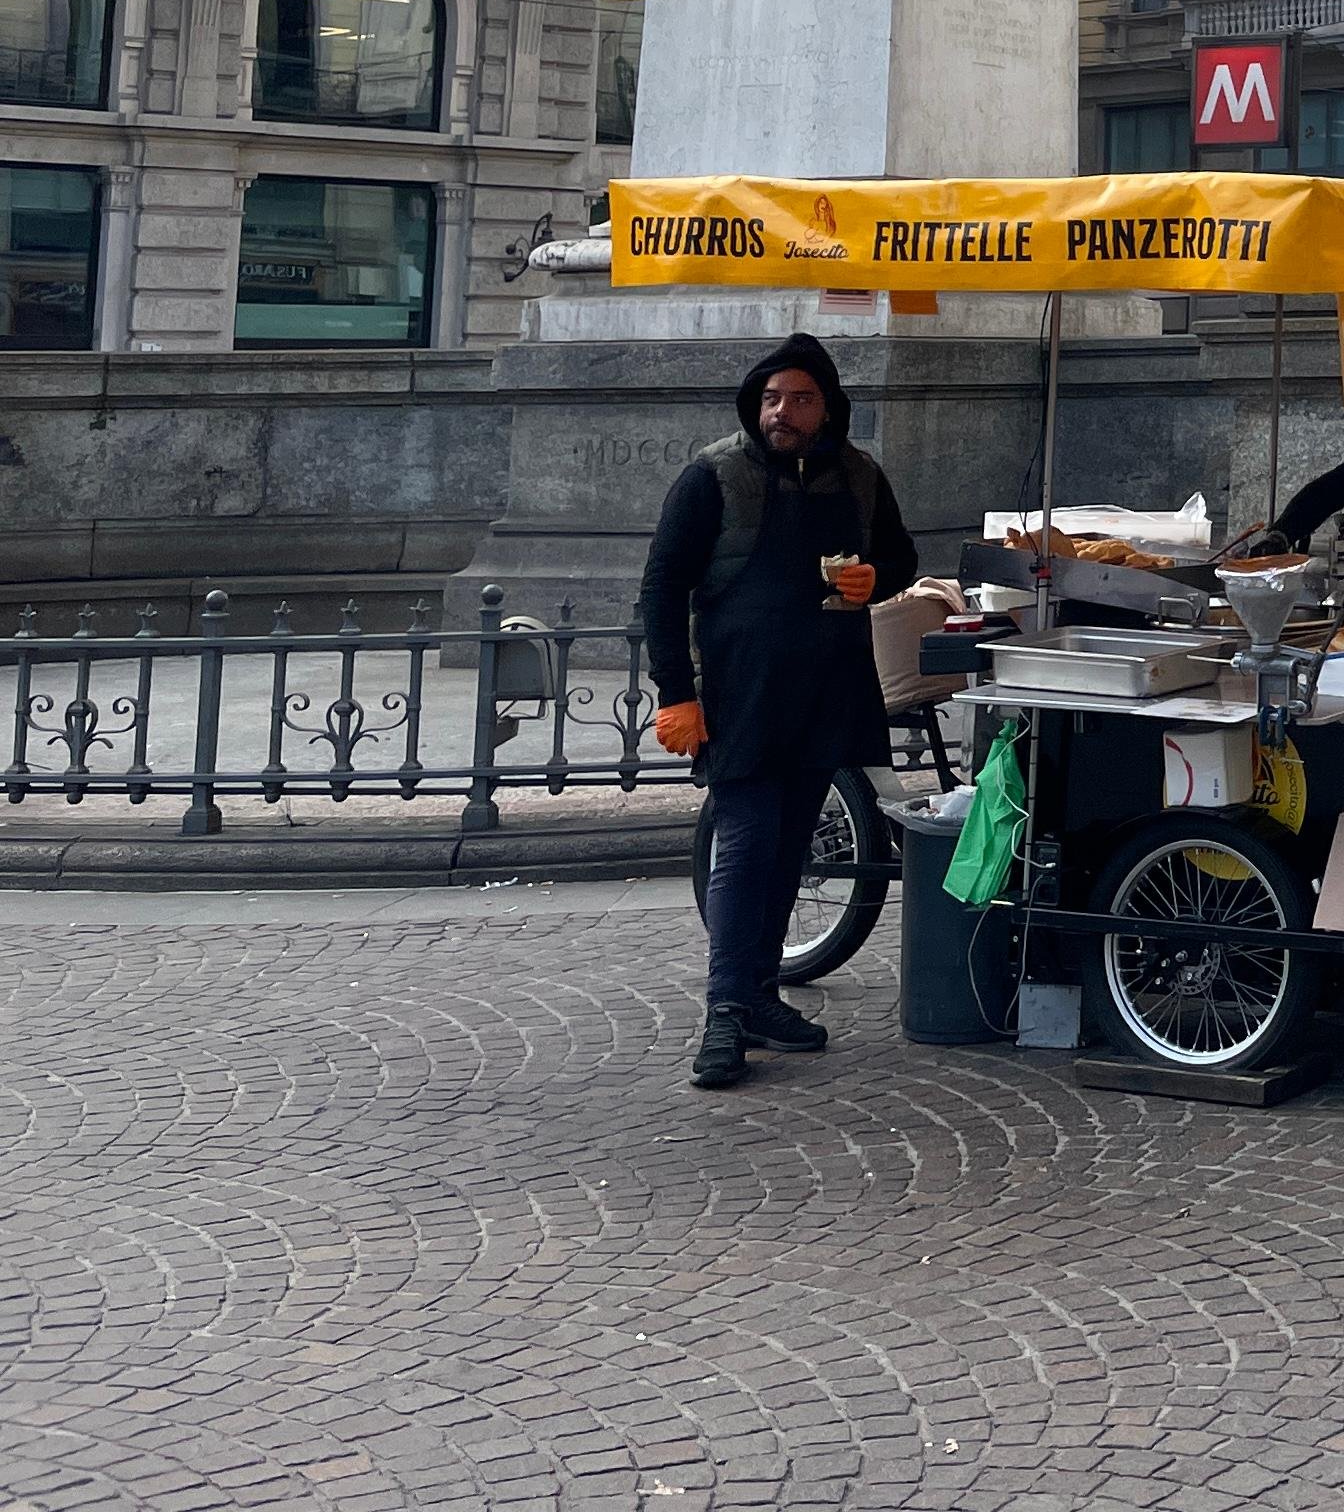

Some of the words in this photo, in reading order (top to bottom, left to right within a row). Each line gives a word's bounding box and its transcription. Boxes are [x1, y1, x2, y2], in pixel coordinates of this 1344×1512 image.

[1200, 63, 1275, 124] M
[630, 216, 765, 259] CHURROS
[872, 221, 1032, 262] FRITTELLE
[1066, 217, 1272, 262] PANZEROTTI
